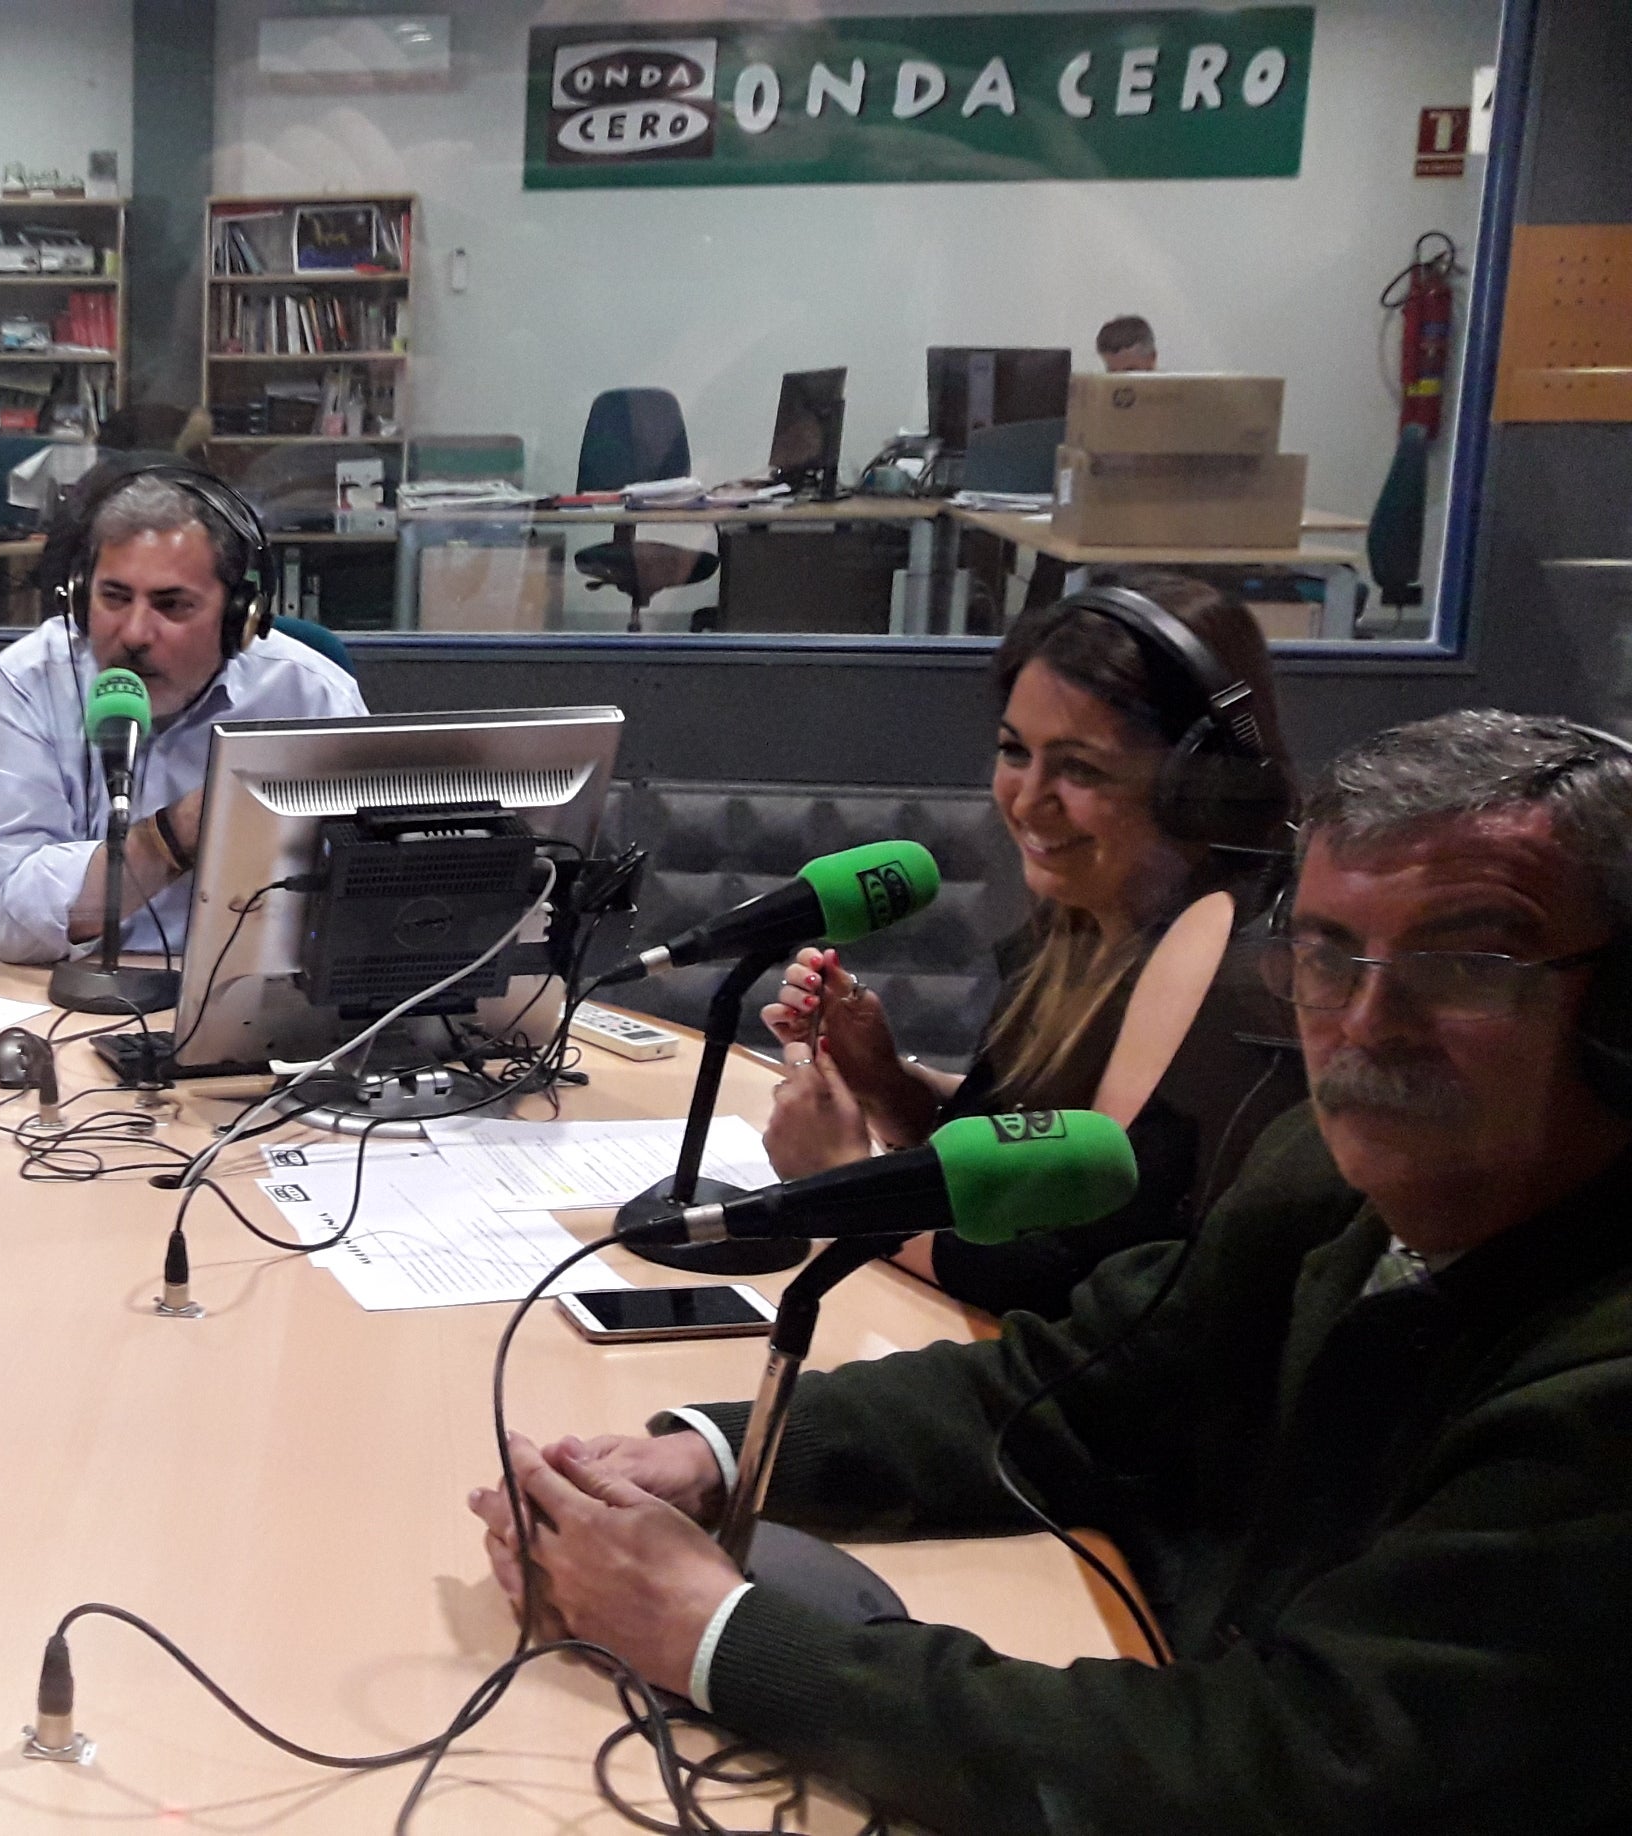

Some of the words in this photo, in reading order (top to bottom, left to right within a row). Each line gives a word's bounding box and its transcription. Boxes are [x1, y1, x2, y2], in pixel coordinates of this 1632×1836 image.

[573, 63, 691, 95] ONDA
[734, 56, 1016, 134] ONDA
[1058, 44, 1286, 118] CERO
[578, 111, 690, 143] CERO
